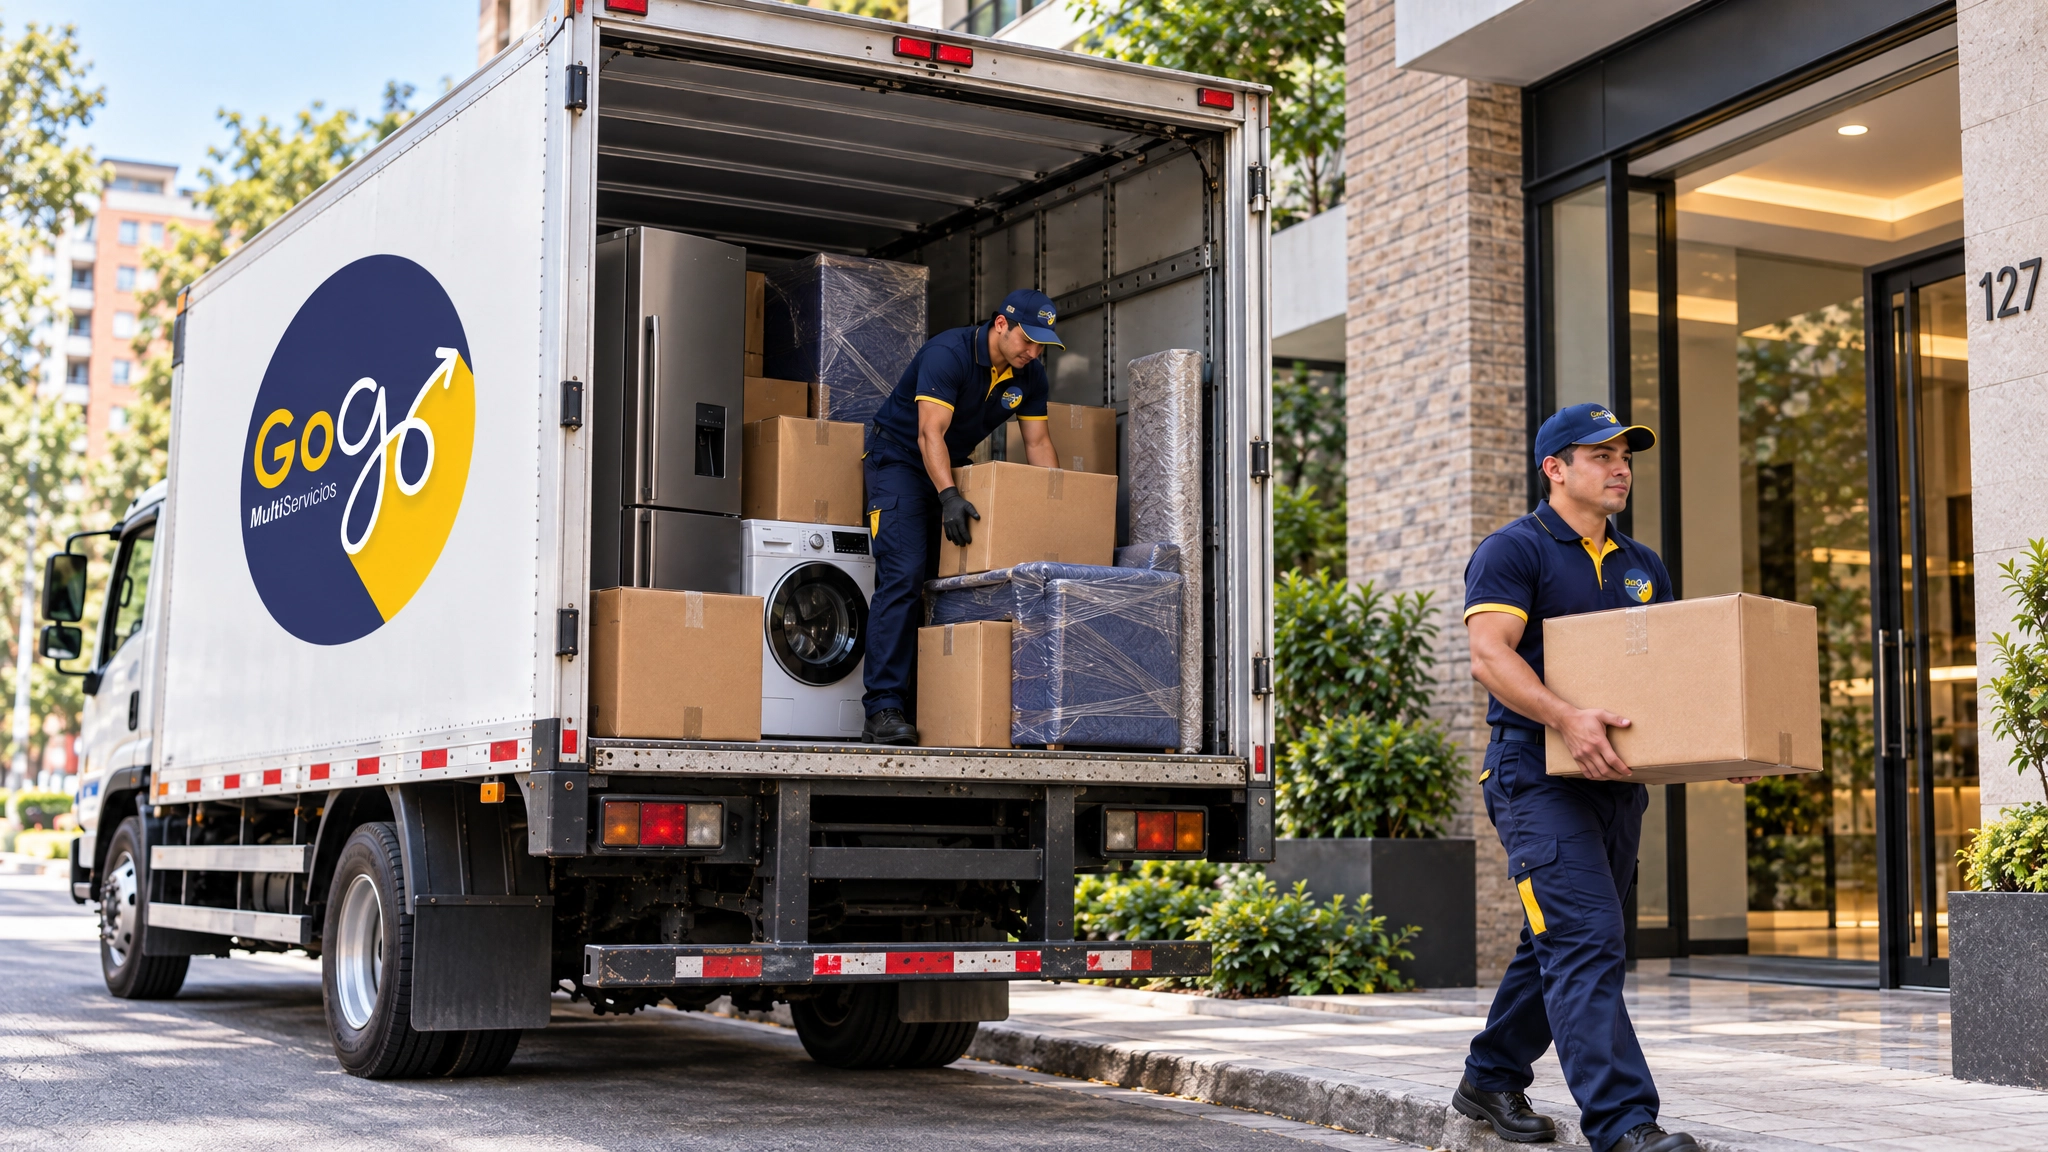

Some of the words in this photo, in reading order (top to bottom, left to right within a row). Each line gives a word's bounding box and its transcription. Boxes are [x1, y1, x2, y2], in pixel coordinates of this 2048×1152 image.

[1979, 257, 2042, 321] 127
[253, 347, 458, 555] Gogo
[250, 482, 337, 529] MultiServicios
